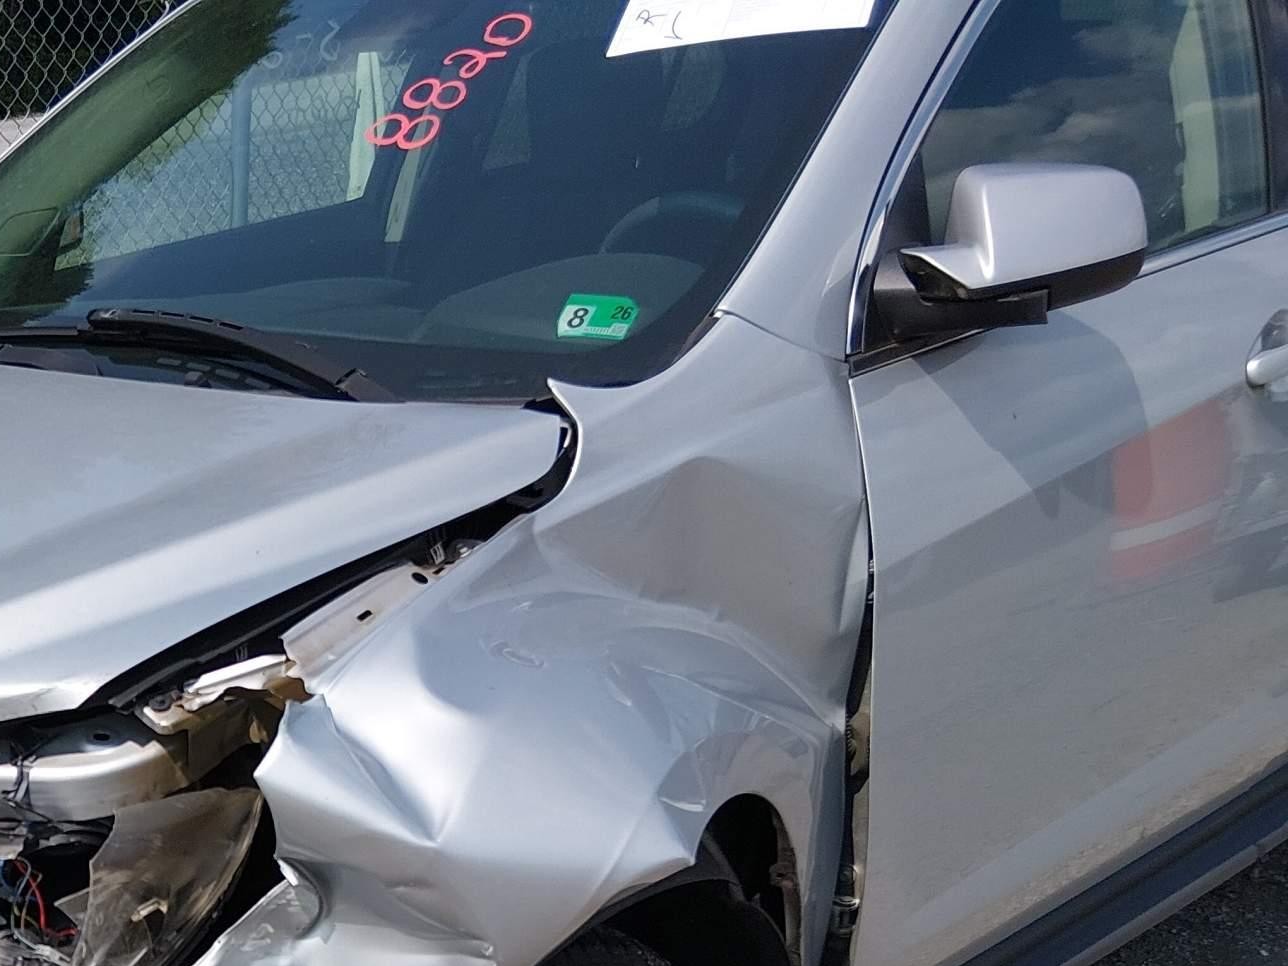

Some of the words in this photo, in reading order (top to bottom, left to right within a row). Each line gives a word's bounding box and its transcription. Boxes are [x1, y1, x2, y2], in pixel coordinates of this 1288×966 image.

[364, 13, 532, 149] 8820
[567, 307, 589, 329] 8
[610, 305, 634, 321] 26
